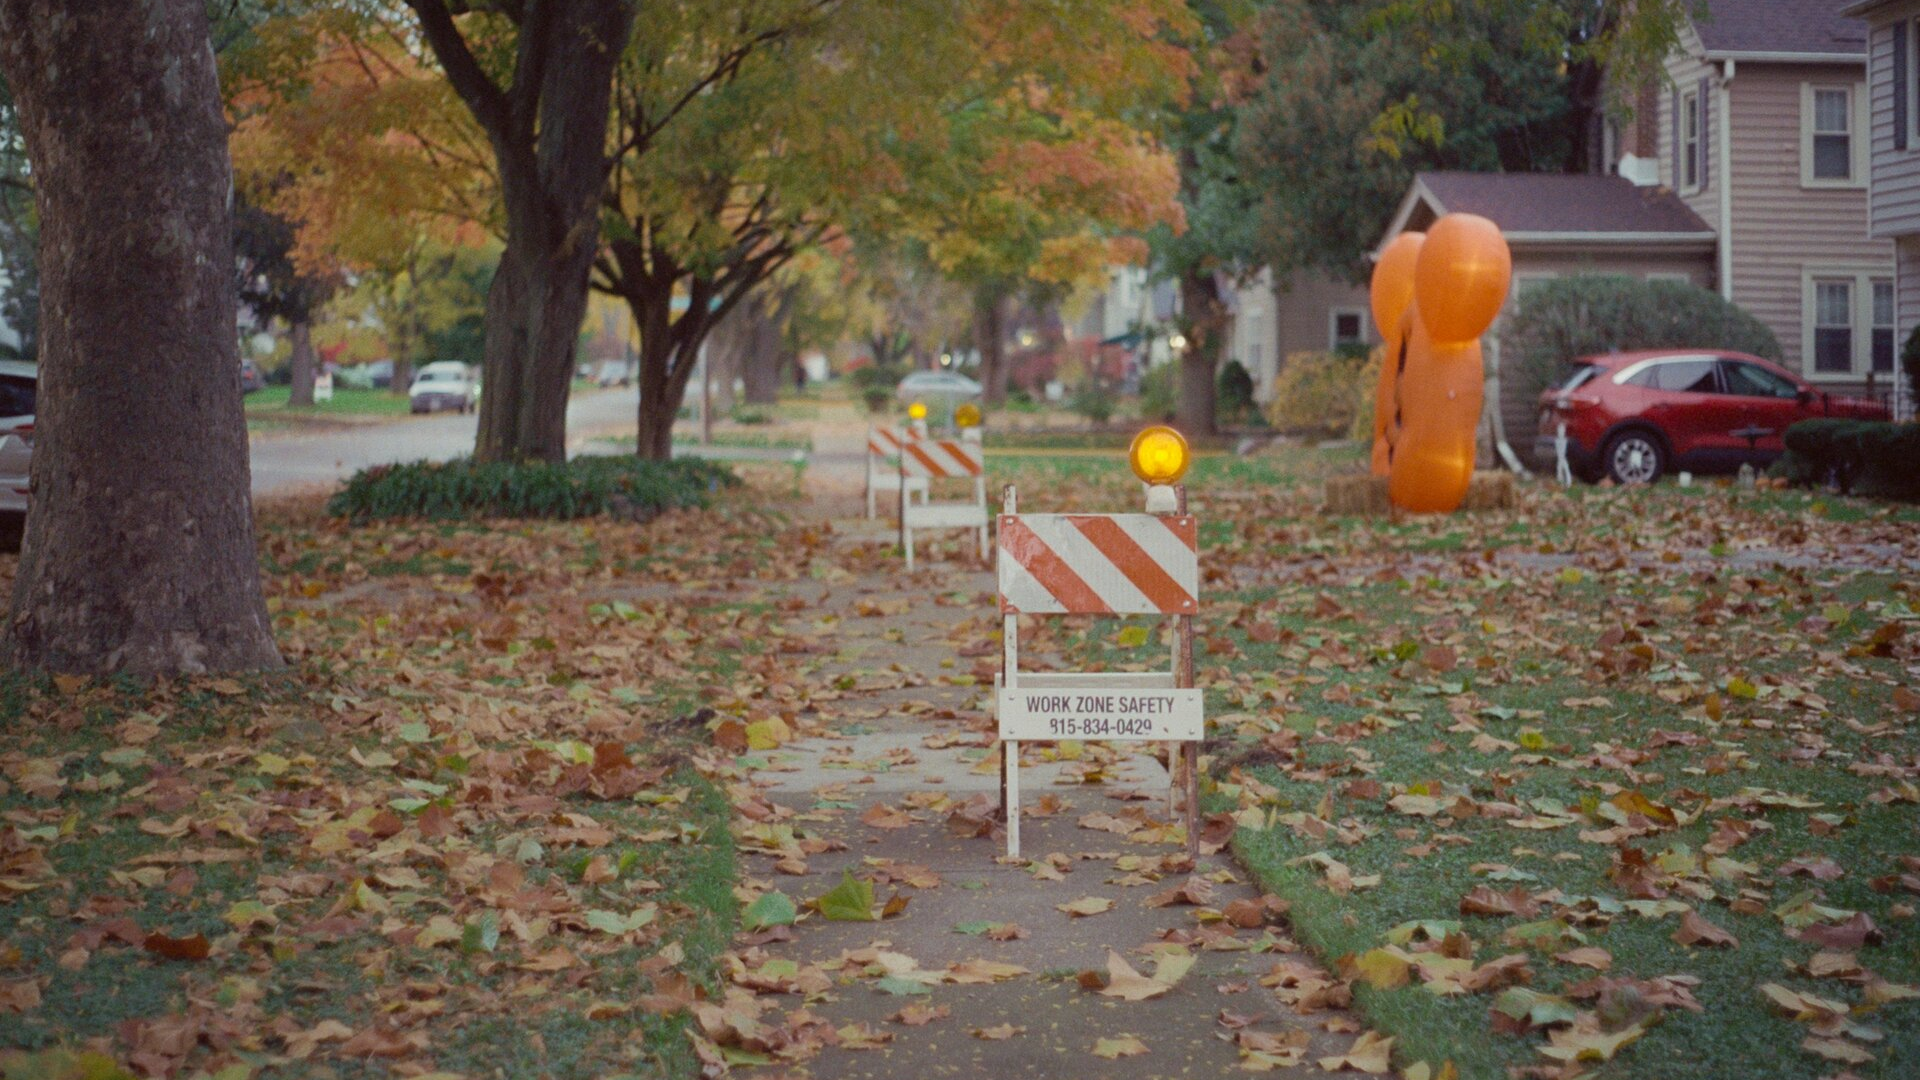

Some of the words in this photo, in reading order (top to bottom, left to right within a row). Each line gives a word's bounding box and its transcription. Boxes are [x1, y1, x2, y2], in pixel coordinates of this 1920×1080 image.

[1026, 696, 1072, 713] WORK
[1076, 696, 1114, 713] ZONE
[1119, 697, 1175, 713] SAFETY
